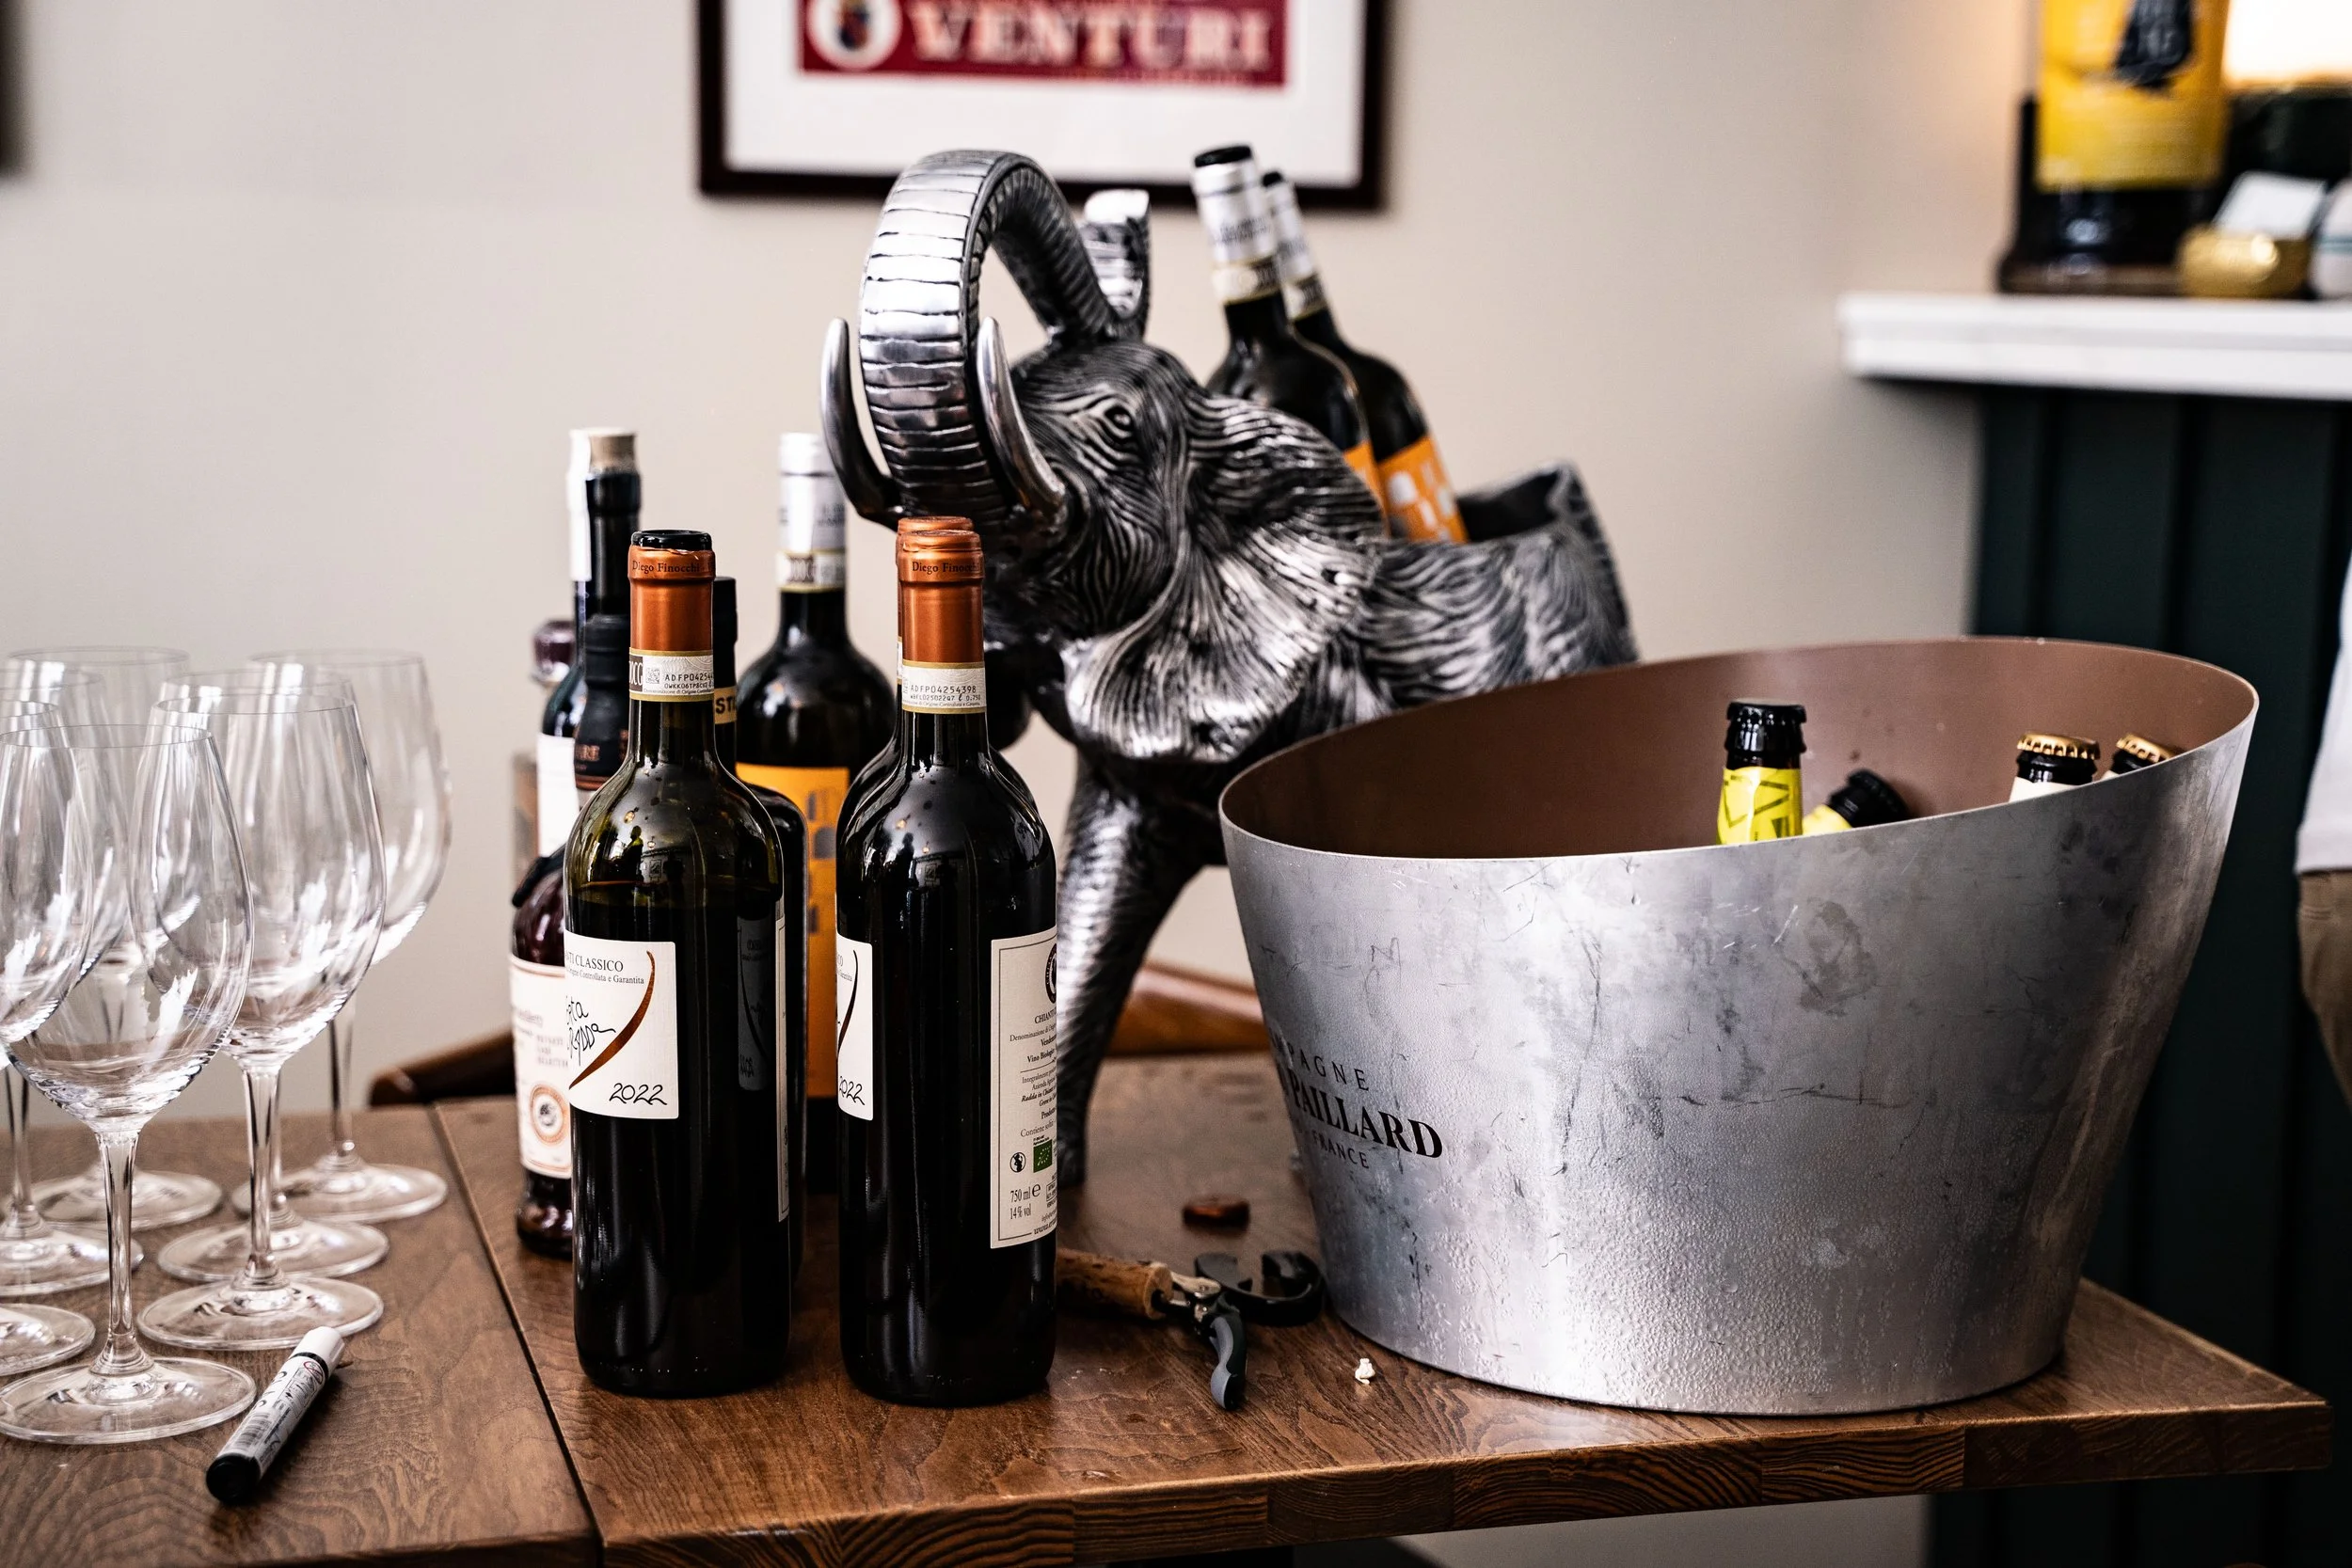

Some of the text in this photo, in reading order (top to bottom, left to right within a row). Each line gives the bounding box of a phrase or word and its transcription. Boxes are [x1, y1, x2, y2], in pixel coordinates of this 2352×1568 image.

[906, 3, 1270, 71] VENTURI
[632, 561, 654, 574] Diego
[912, 562, 939, 575] Diego
[911, 685, 977, 694] ADFP04254398
[575, 954, 624, 972] CLASSICO
[613, 974, 644, 985] Garantita
[1027, 1054, 1040, 1063] Vino
[609, 1083, 667, 1105] 2022
[1022, 1093, 1037, 1102] Radda
[1288, 1068, 1442, 1159] PAILLARD
[1021, 1125, 1044, 1137] Contiene
[1311, 1130, 1370, 1169] FRANCE
[1009, 1188, 1022, 1202] 750
[1024, 1186, 1030, 1200] ml
